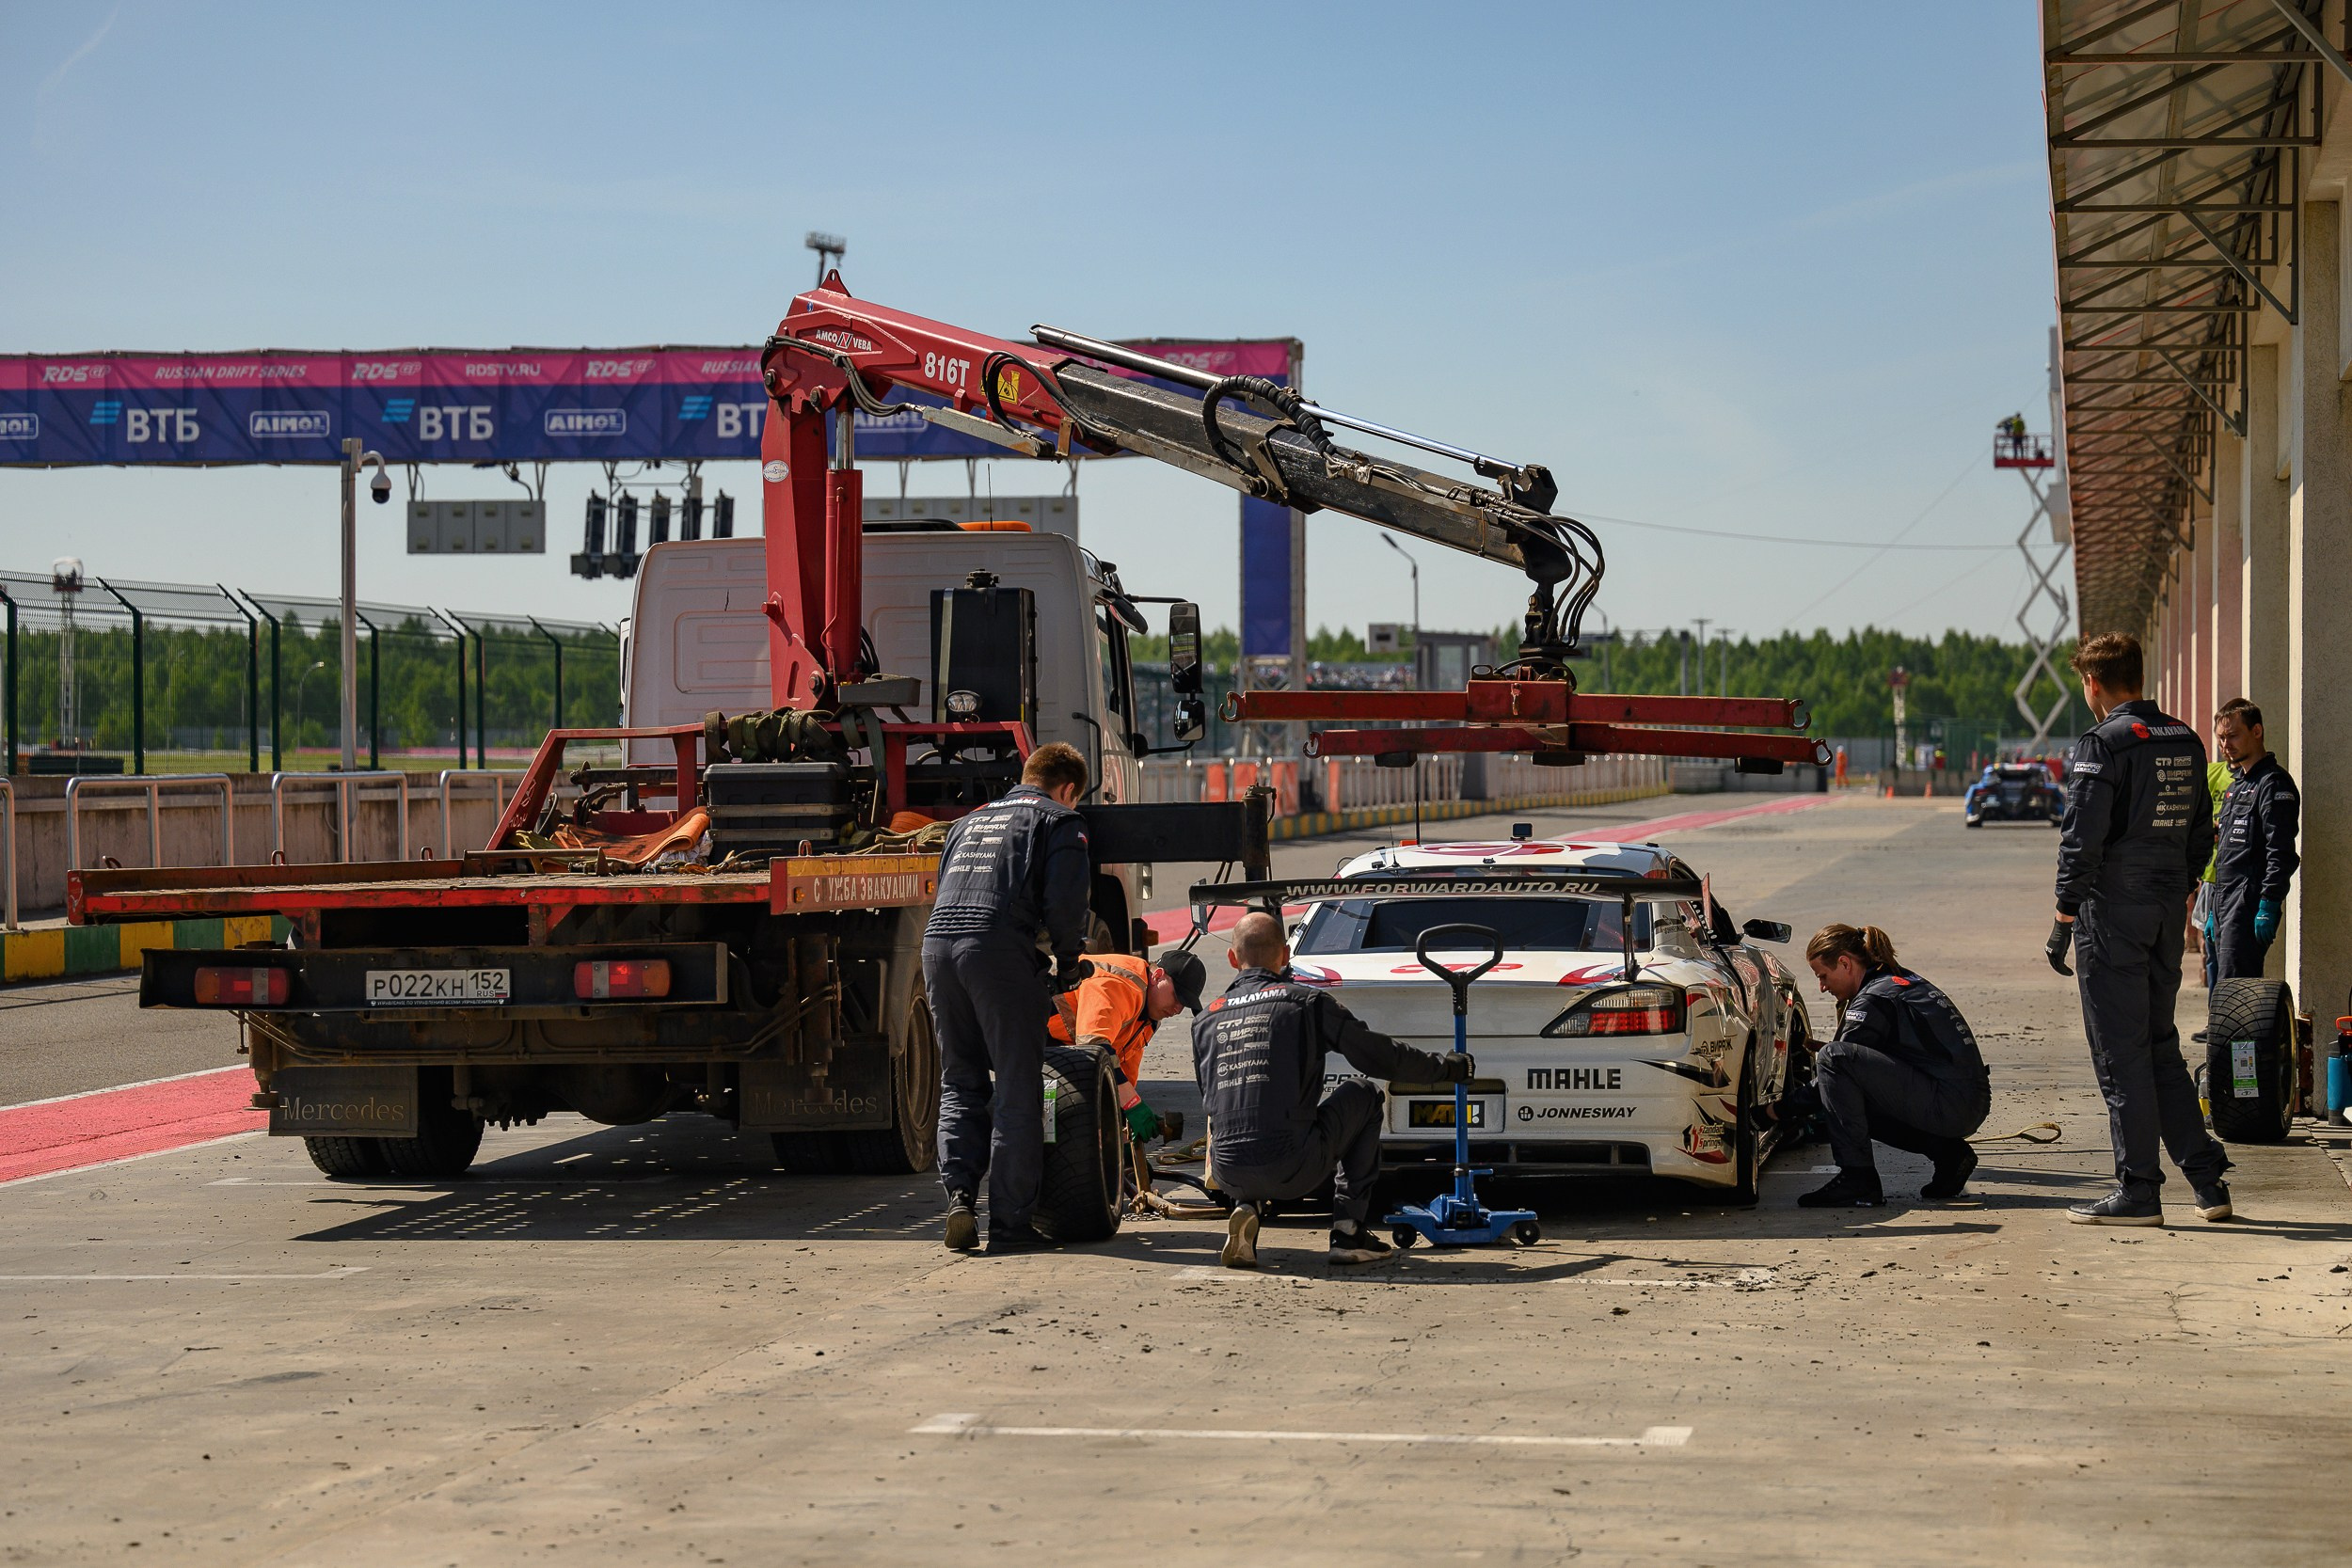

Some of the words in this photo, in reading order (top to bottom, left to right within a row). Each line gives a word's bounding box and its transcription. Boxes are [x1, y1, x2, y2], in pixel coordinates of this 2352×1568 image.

[815, 329, 838, 343] AMCO
[852, 339, 872, 352] VEBA
[154, 366, 215, 380] RUSSIAN
[215, 365, 258, 379] DRIFT
[258, 365, 307, 378] SERIES
[466, 363, 541, 377] RDSTV.RU
[924, 351, 970, 387] 816T
[127, 408, 200, 443] ВТБ
[254, 417, 326, 433] AIMOL
[420, 405, 494, 441] ВТБ
[548, 414, 621, 431] AIMOL
[717, 403, 767, 438] ВТ
[814, 876, 857, 903] СУЖБА
[860, 874, 919, 902] ЭВАКУАЦИИ
[1286, 881, 1599, 896] WWW.FORWARDAUTO.RU
[469, 972, 504, 990] 152
[476, 990, 495, 998] RUS
[1227, 989, 1288, 1006] TAKAYAMA
[1229, 1059, 1269, 1070] KASHIYAMA
[1217, 1077, 1243, 1090] MAHLE
[1527, 1068, 1621, 1089] MAHLE
[283, 1097, 405, 1121] Mercedes
[1537, 1106, 1638, 1118] JONNESWAY
